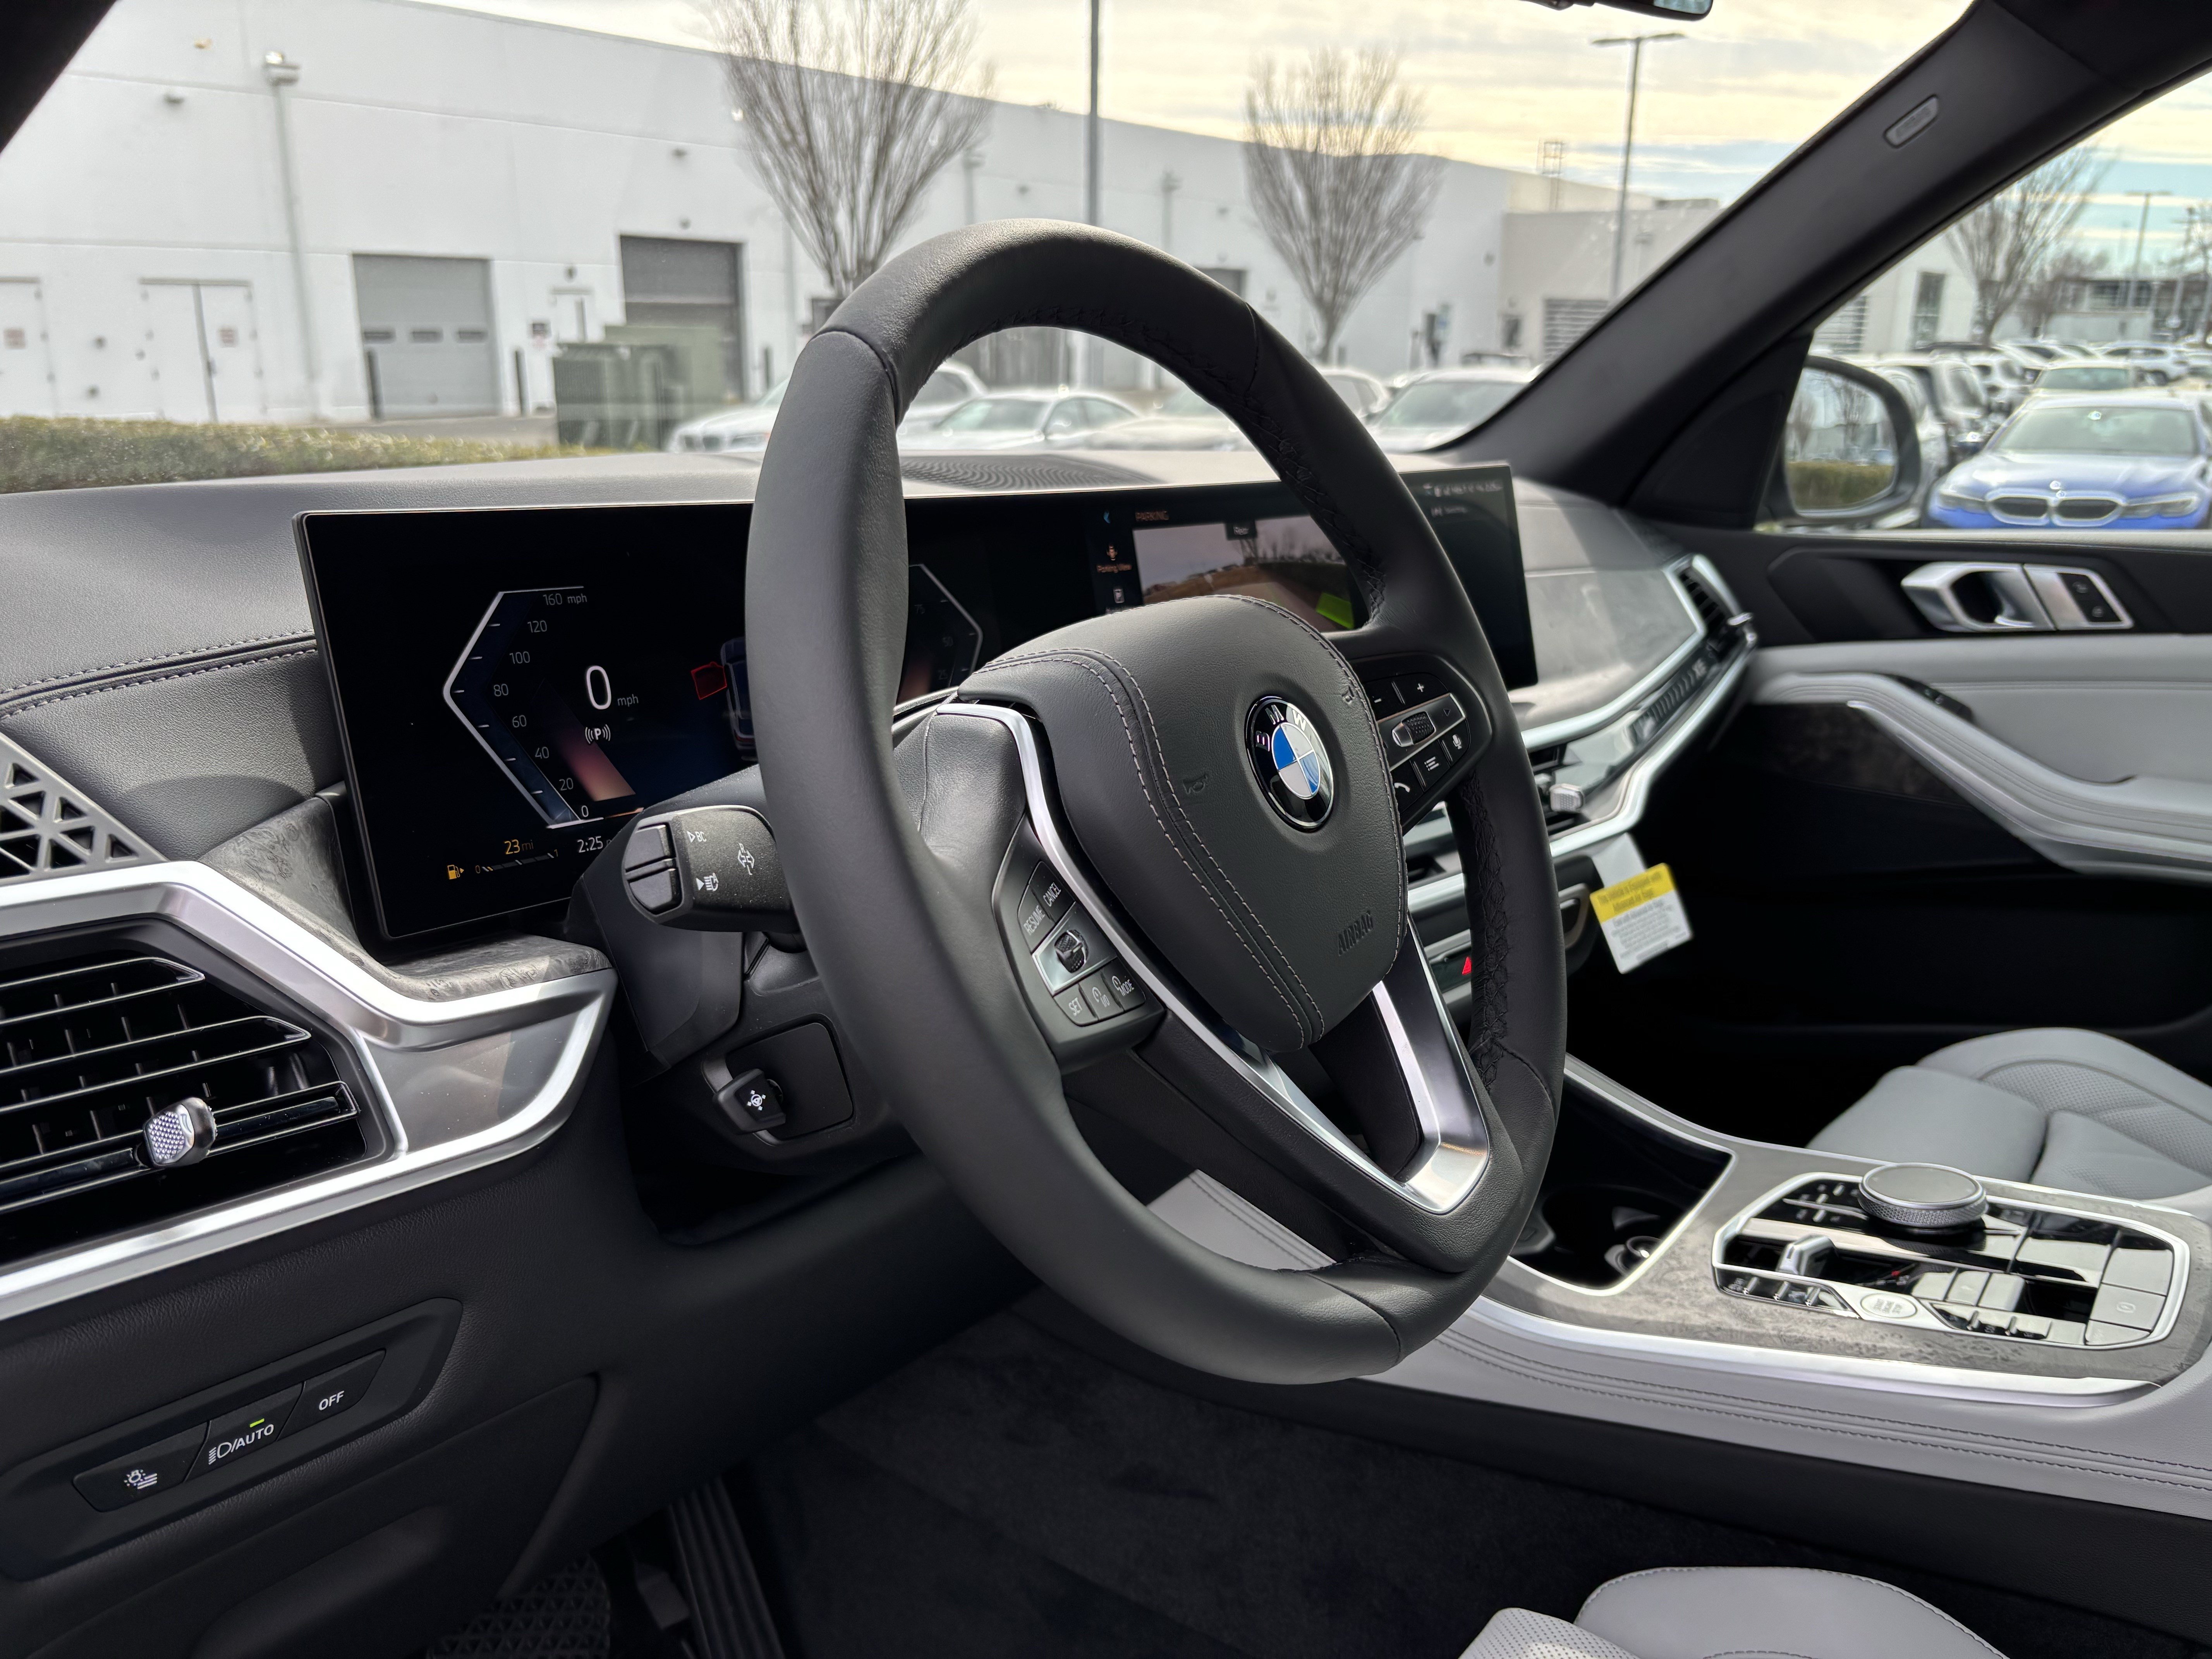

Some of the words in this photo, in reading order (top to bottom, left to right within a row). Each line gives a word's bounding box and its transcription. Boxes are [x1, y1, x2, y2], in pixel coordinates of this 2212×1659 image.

[543, 593, 562, 605] 160
[567, 594, 587, 604] mph
[527, 620, 547, 632] 120
[510, 651, 530, 664] 100
[494, 684, 508, 696] 80
[586, 666, 611, 709] 0
[617, 694, 638, 706] mph
[512, 715, 526, 728] 60
[1255, 704, 1307, 752] BMW
[535, 747, 549, 758] 40
[559, 778, 573, 791] 20
[582, 805, 588, 817] 0
[696, 831, 706, 842] BC
[505, 839, 520, 854] 23
[522, 840, 533, 851] mi
[577, 836, 603, 853] 2:25
[1043, 882, 1061, 907] CANCEL
[1024, 905, 1044, 936] RESUME
[1338, 910, 1373, 956] AIRBAG
[1118, 980, 1134, 996] MODE
[1069, 998, 1082, 1015] SET
[319, 1391, 344, 1410] OFF
